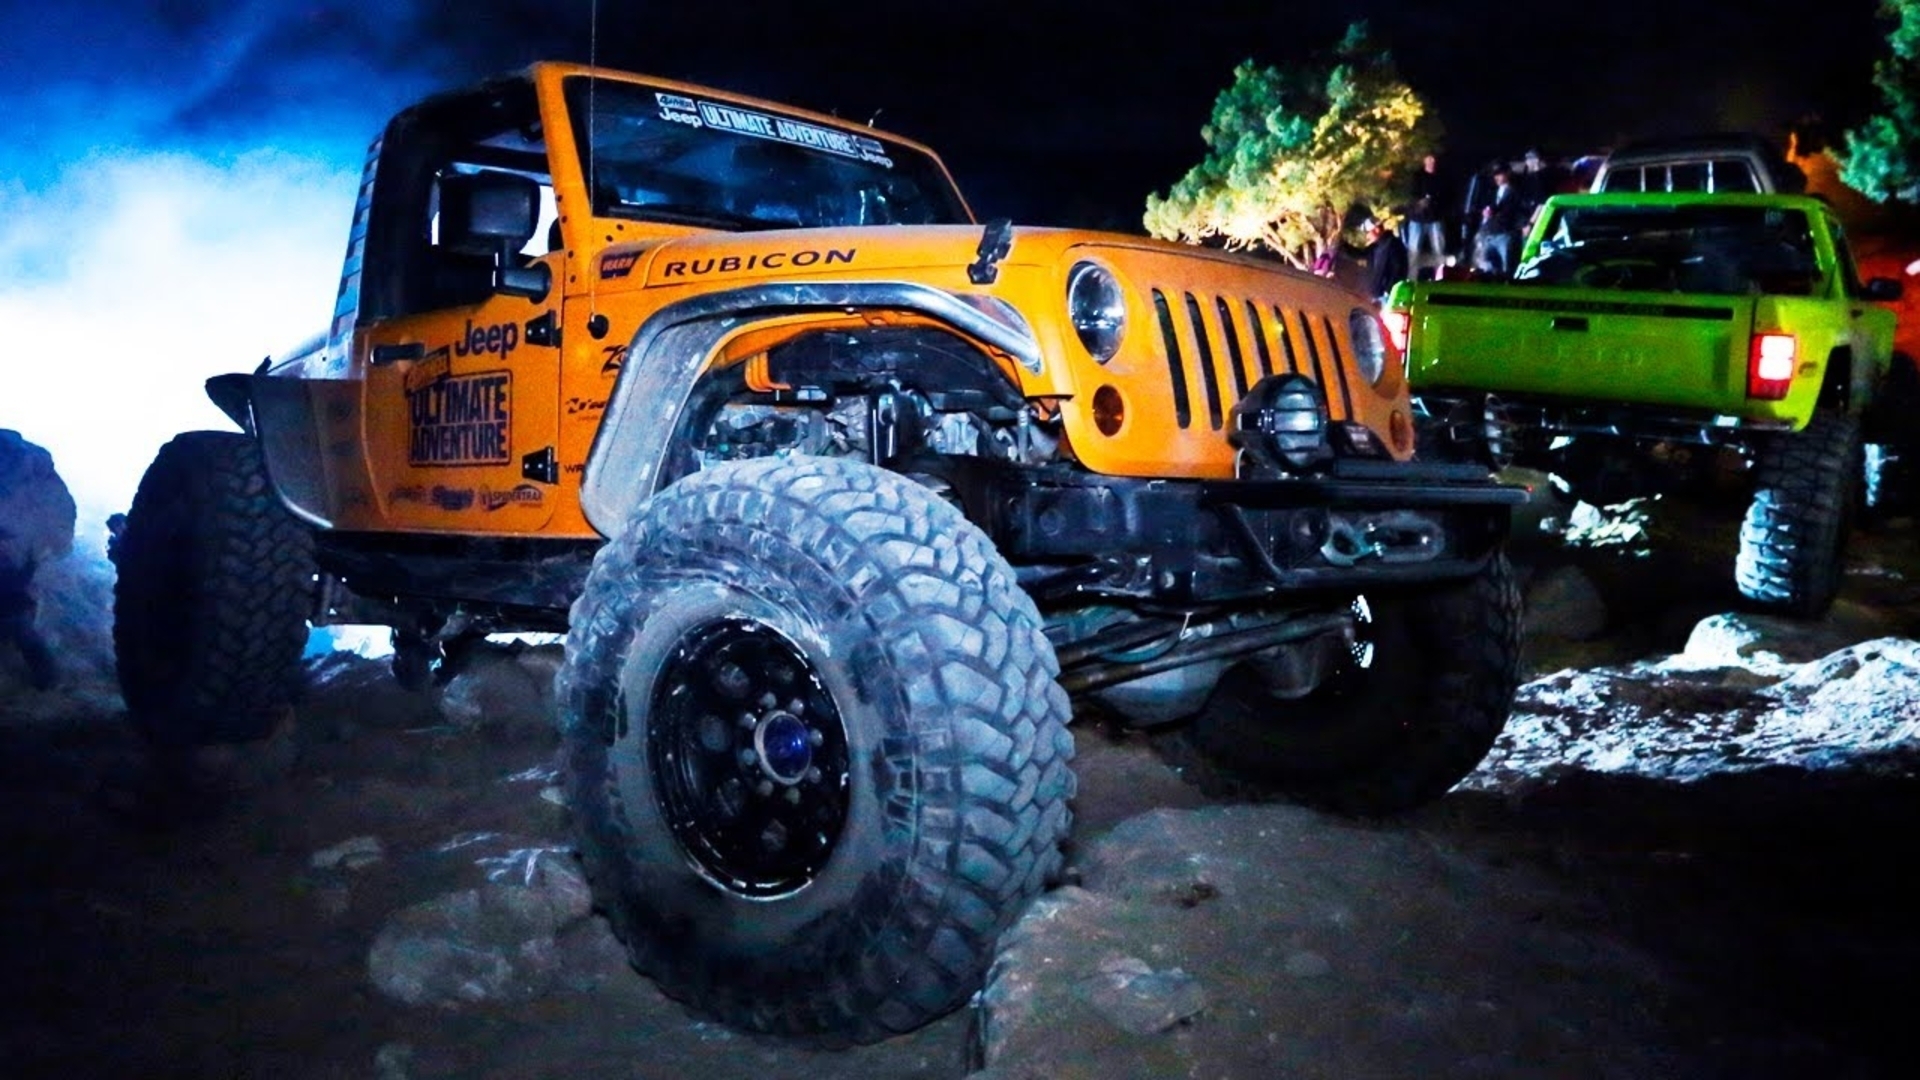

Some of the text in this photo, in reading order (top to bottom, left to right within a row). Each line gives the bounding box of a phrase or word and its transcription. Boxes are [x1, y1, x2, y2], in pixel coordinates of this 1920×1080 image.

[659, 107, 704, 129] Jeep
[704, 105, 775, 136] ULTIMATE
[777, 121, 854, 154] ADVENTURE
[858, 149, 893, 169] Jeep
[664, 249, 856, 278] RUBICON
[455, 319, 519, 360] Jeep
[411, 376, 507, 427] ULTIMATE
[412, 422, 507, 462] ADVENTURE
